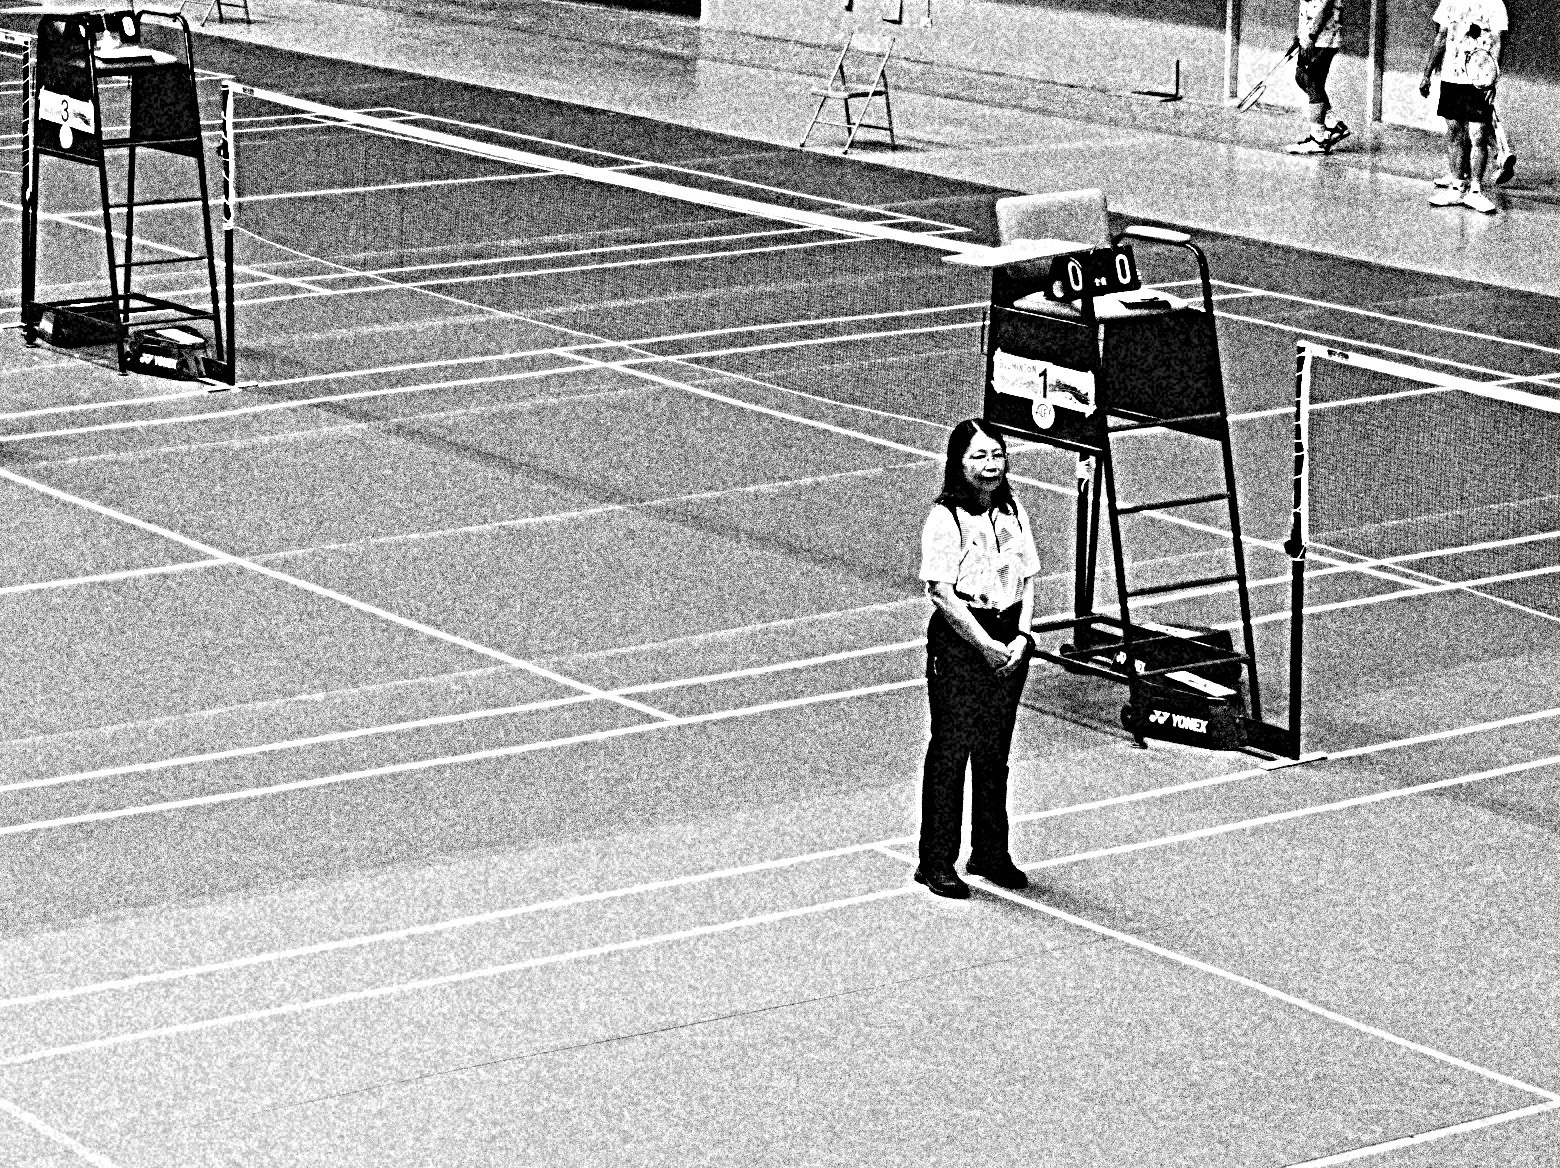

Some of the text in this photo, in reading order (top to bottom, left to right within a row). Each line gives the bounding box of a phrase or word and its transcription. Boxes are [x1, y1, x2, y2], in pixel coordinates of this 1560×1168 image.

[60, 99, 70, 123] 3
[1067, 253, 1132, 292] 0 0
[998, 358, 1037, 374] BMINON
[1038, 367, 1048, 399] 1
[1171, 713, 1209, 734] YONEX
